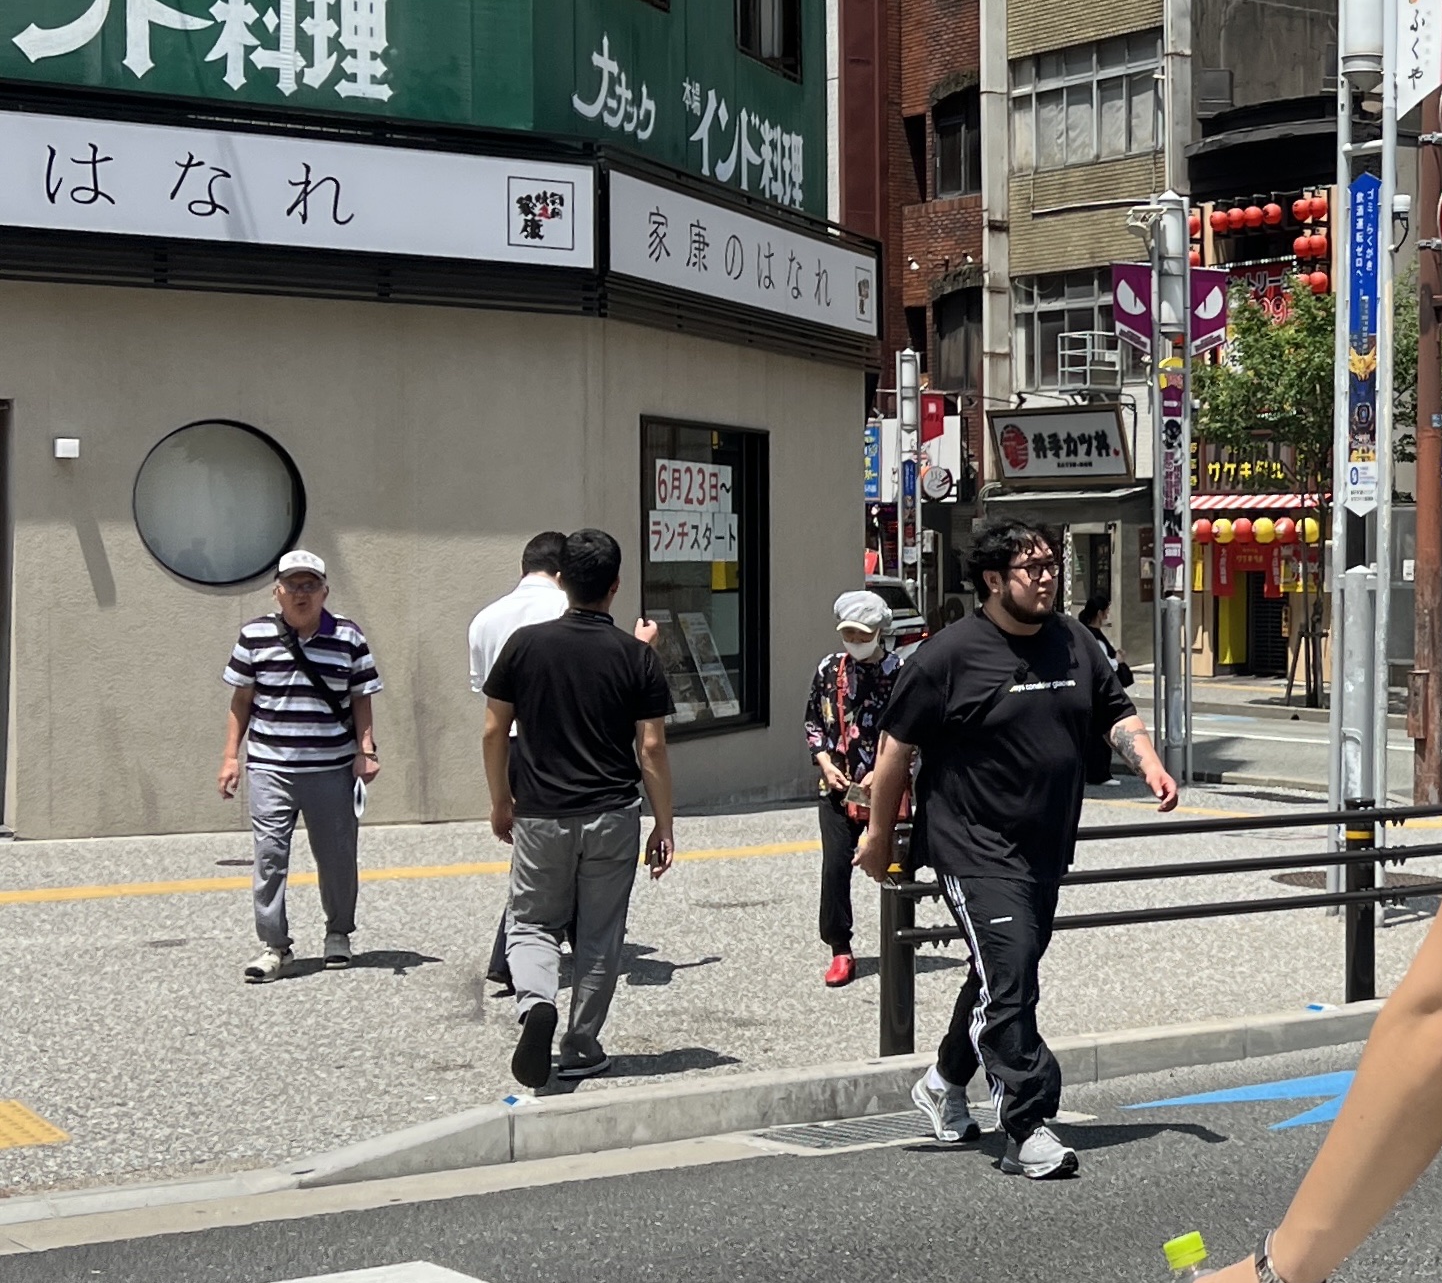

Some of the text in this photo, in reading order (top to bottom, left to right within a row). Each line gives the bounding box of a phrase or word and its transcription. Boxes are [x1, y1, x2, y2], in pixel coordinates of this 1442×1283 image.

[1407, 9, 1426, 91] ふくや
[46, 143, 355, 226] はなれ
[690, 89, 804, 211] インド料理
[648, 205, 831, 308] 家康のはなれ
[650, 520, 737, 552] ランチスタート
